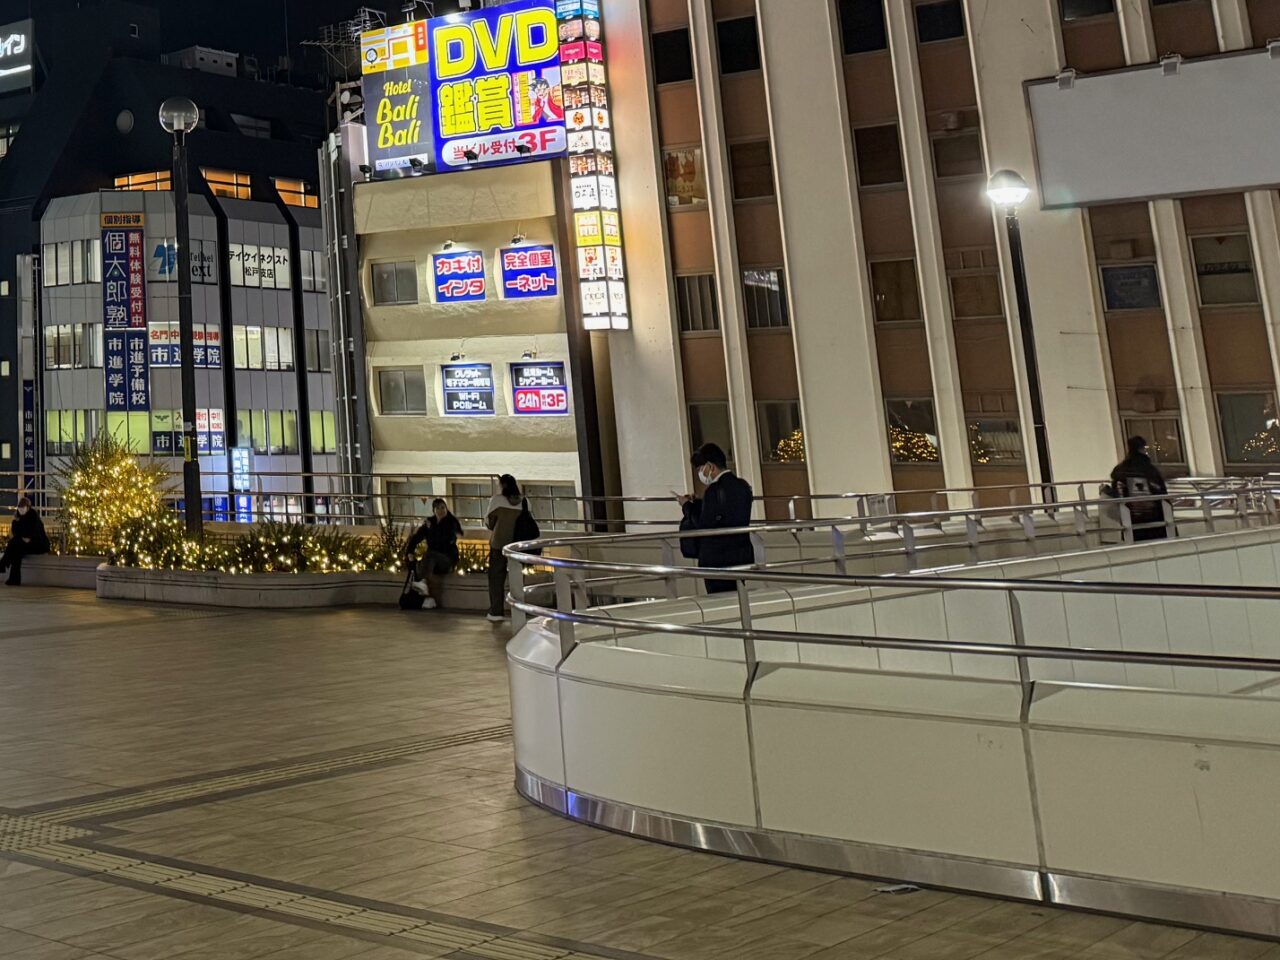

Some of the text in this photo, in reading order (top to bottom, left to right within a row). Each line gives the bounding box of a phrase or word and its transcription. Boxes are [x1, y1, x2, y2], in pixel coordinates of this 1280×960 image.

[434, 6, 559, 78] DVD
[383, 78, 413, 97] Hotel
[376, 94, 420, 125] Bali
[438, 73, 515, 138] 鑑賞
[377, 119, 422, 149] Bali
[519, 128, 557, 152] 3F
[244, 266, 275, 279] 松戸支店
[504, 249, 554, 271] 完全個室
[104, 231, 128, 329] 個太郎塾
[128, 232, 144, 327] 無料体験受付中
[107, 337, 126, 406] 市進学院
[129, 337, 146, 406] 市進予備校
[517, 392, 540, 410] 24h
[546, 392, 566, 408] 3F
